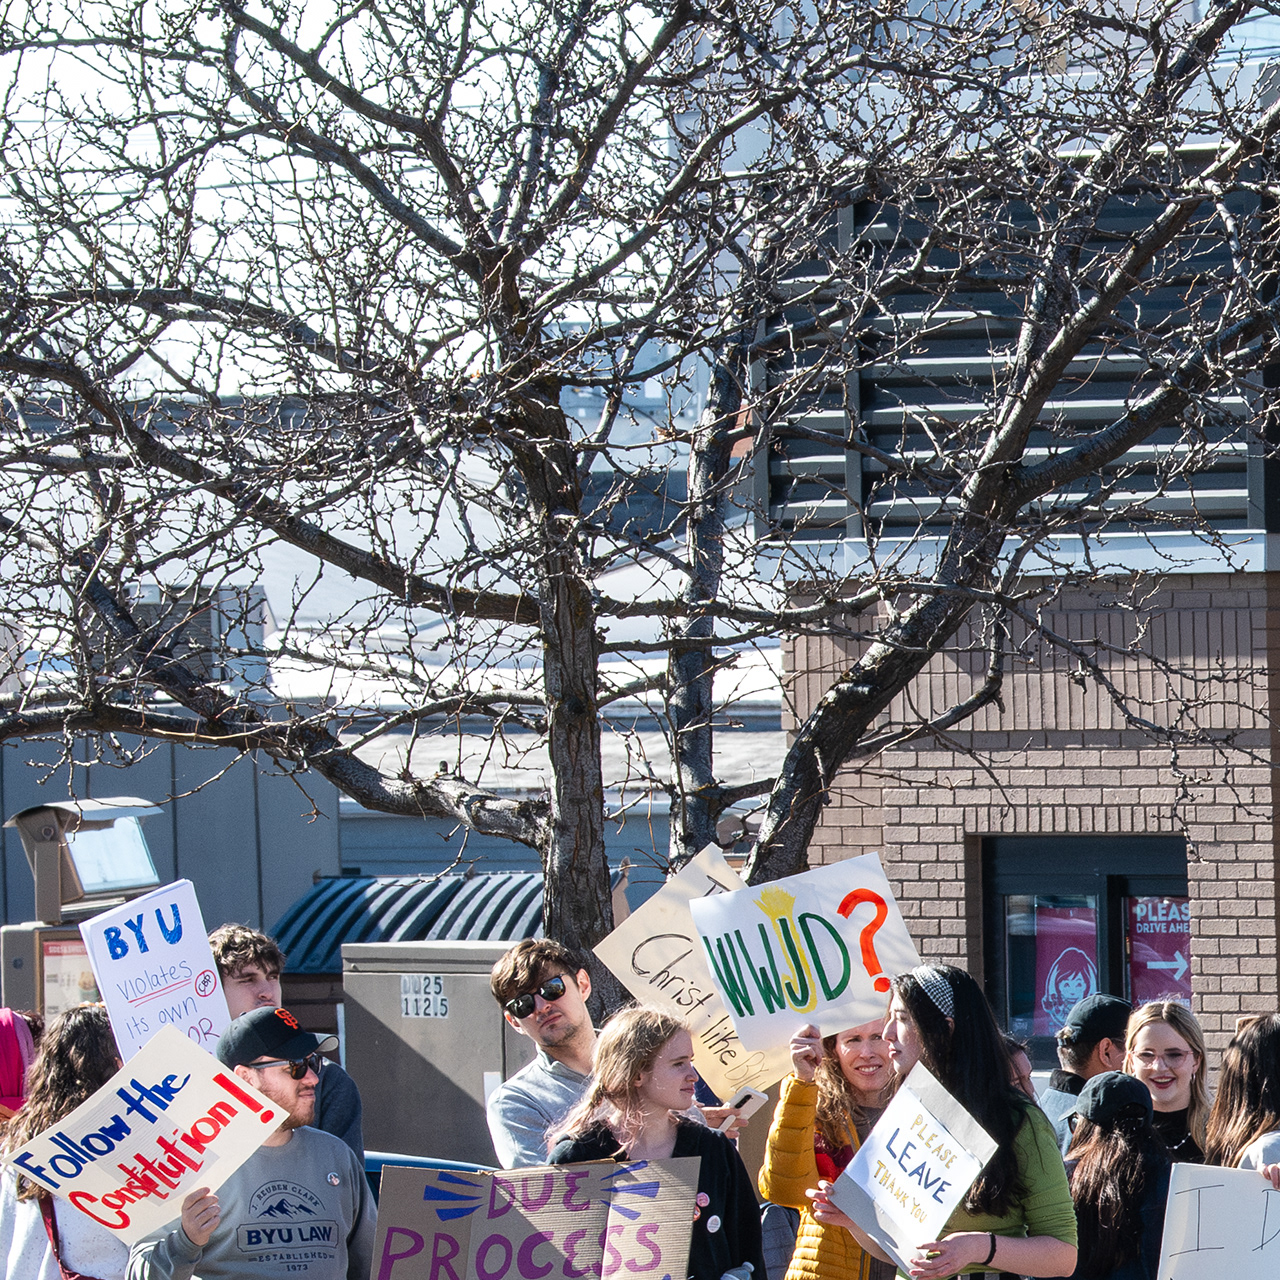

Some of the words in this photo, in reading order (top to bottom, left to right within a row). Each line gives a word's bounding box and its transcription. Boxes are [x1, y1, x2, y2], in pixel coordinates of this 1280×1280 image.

[103, 903, 183, 960] BYU
[703, 888, 890, 1017] WWJD?
[1136, 923, 1168, 933] DRIVE
[1168, 923, 1190, 933] AHE
[126, 1016, 150, 1039] its
[158, 996, 198, 1024] own
[404, 997, 448, 1017] 112.5
[12, 1114, 132, 1189] Follow
[115, 1073, 191, 1125] the
[910, 1113, 957, 1170] PLEASE
[886, 1127, 952, 1205] LEAVE
[256, 1184, 288, 1201] REUBEN
[291, 1186, 320, 1207] CLARK
[487, 1170, 591, 1220] DUE
[873, 1159, 907, 1209] THANK
[910, 1197, 928, 1224] YOU
[246, 1228, 293, 1246] BYU
[298, 1226, 333, 1242] LAW
[1168, 1184, 1225, 1258] I
[258, 1252, 328, 1263] ESTABLISHED
[286, 1264, 309, 1272] 1973
